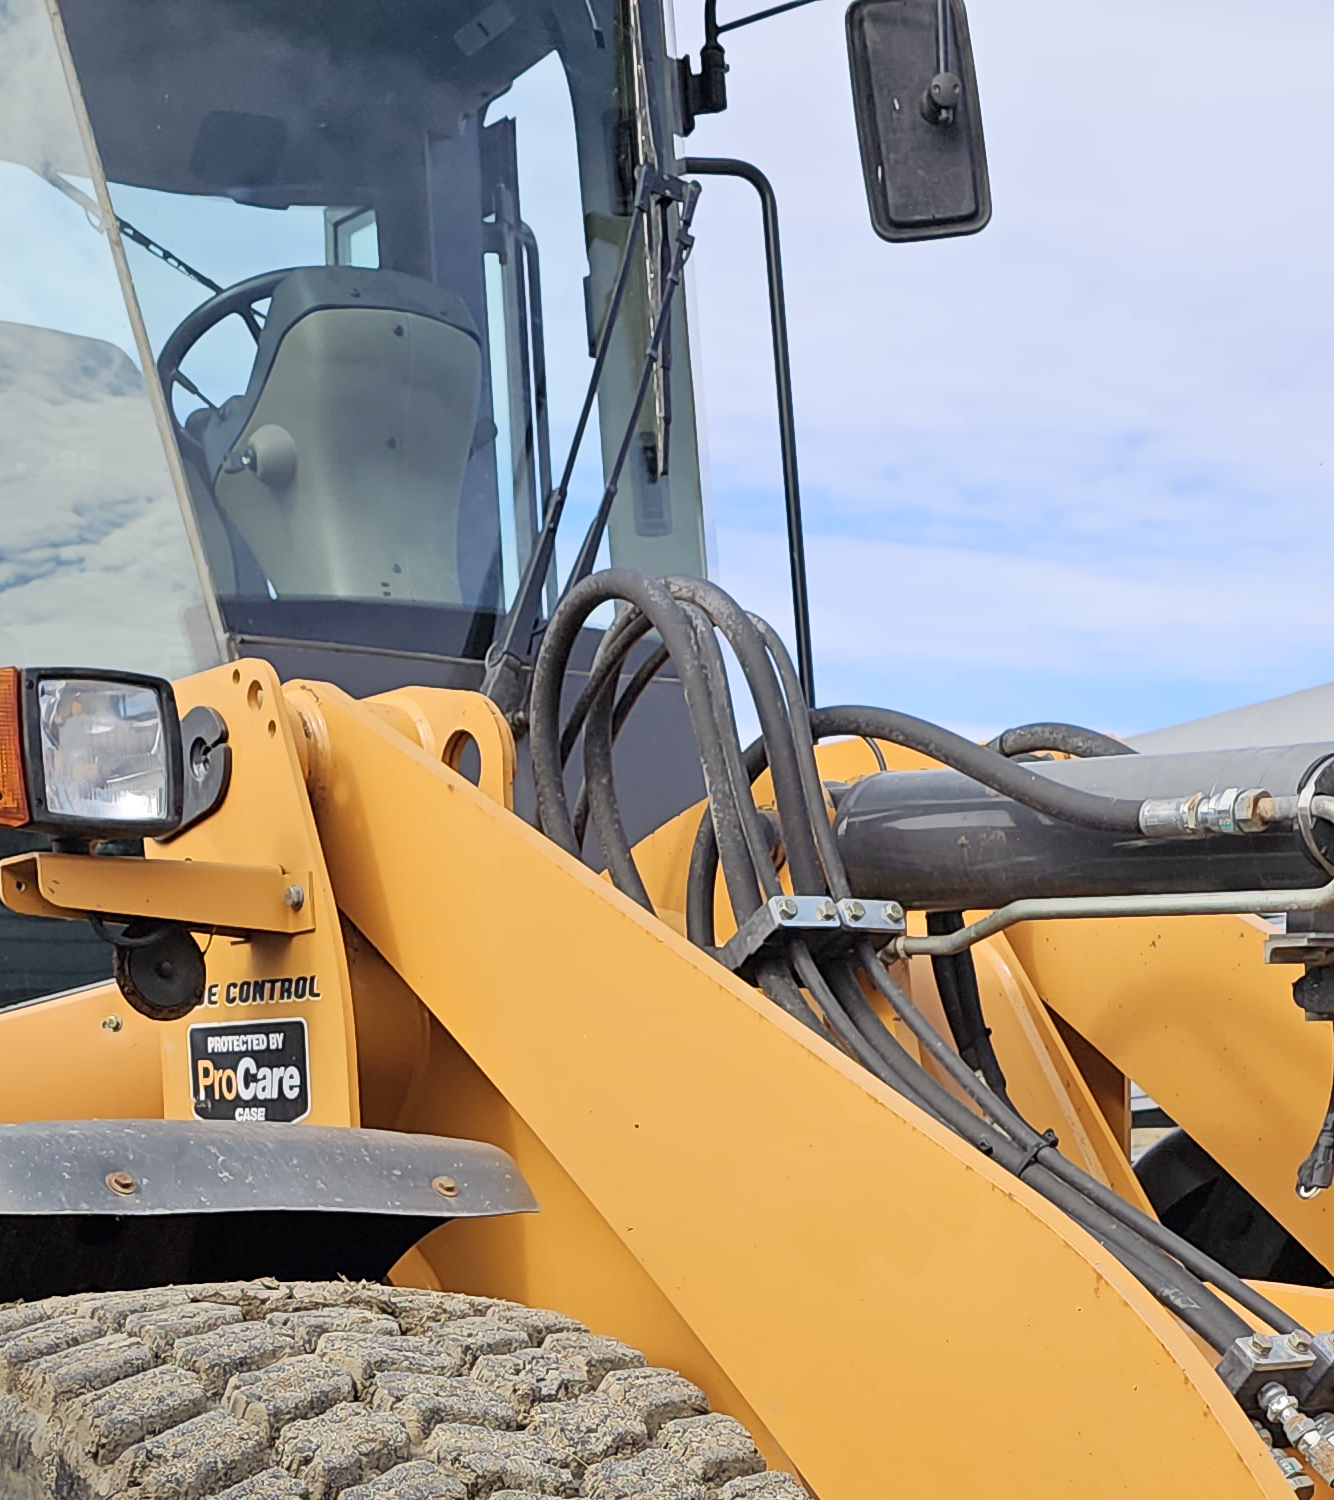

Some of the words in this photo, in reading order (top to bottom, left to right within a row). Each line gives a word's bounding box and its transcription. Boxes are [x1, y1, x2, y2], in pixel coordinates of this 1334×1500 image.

[225, 974, 322, 1005] CONTROL
[207, 1033, 267, 1053] PROTECTED
[268, 1032, 285, 1050] BY
[197, 1056, 301, 1101] ProCare
[234, 1107, 266, 1122] CASE
